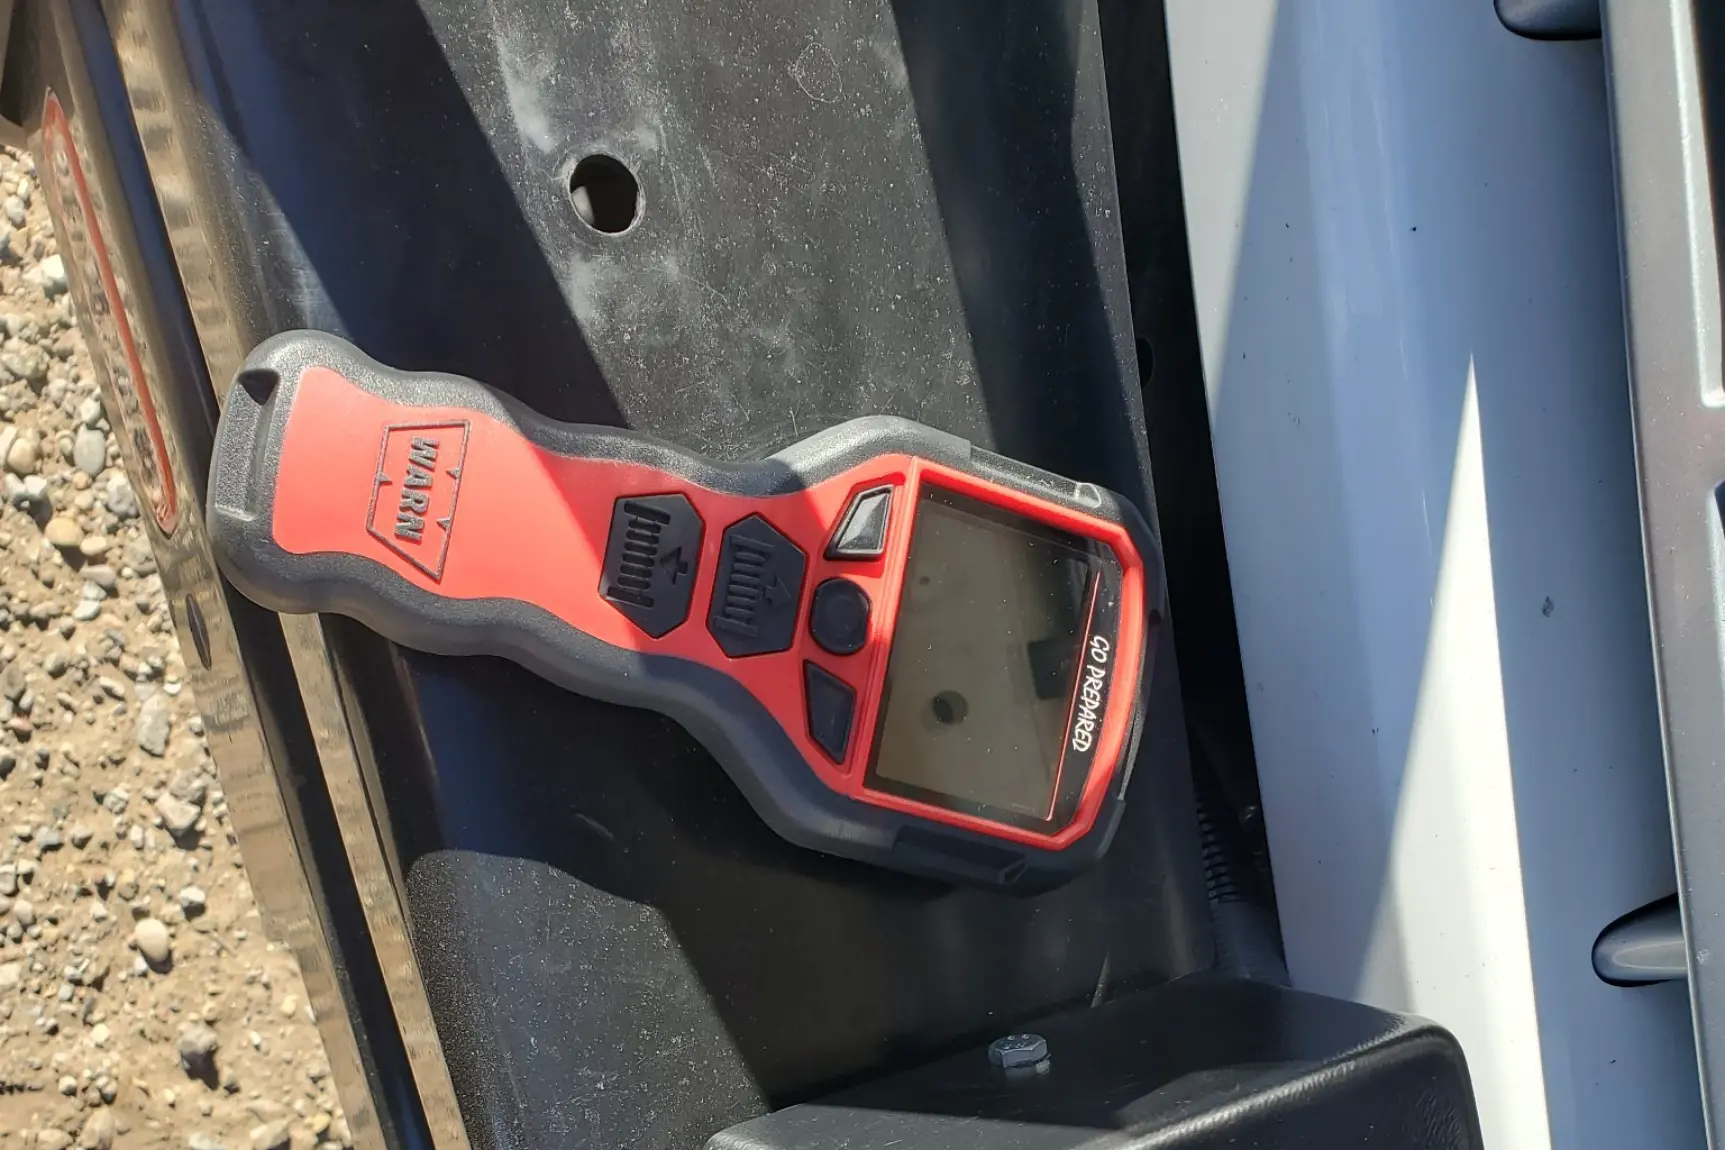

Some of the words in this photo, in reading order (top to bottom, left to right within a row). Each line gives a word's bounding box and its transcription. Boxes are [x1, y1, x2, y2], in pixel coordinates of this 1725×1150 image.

[394, 436, 439, 544] WARN
[1089, 635, 1110, 663] GO
[1072, 664, 1105, 752] PREPARED
